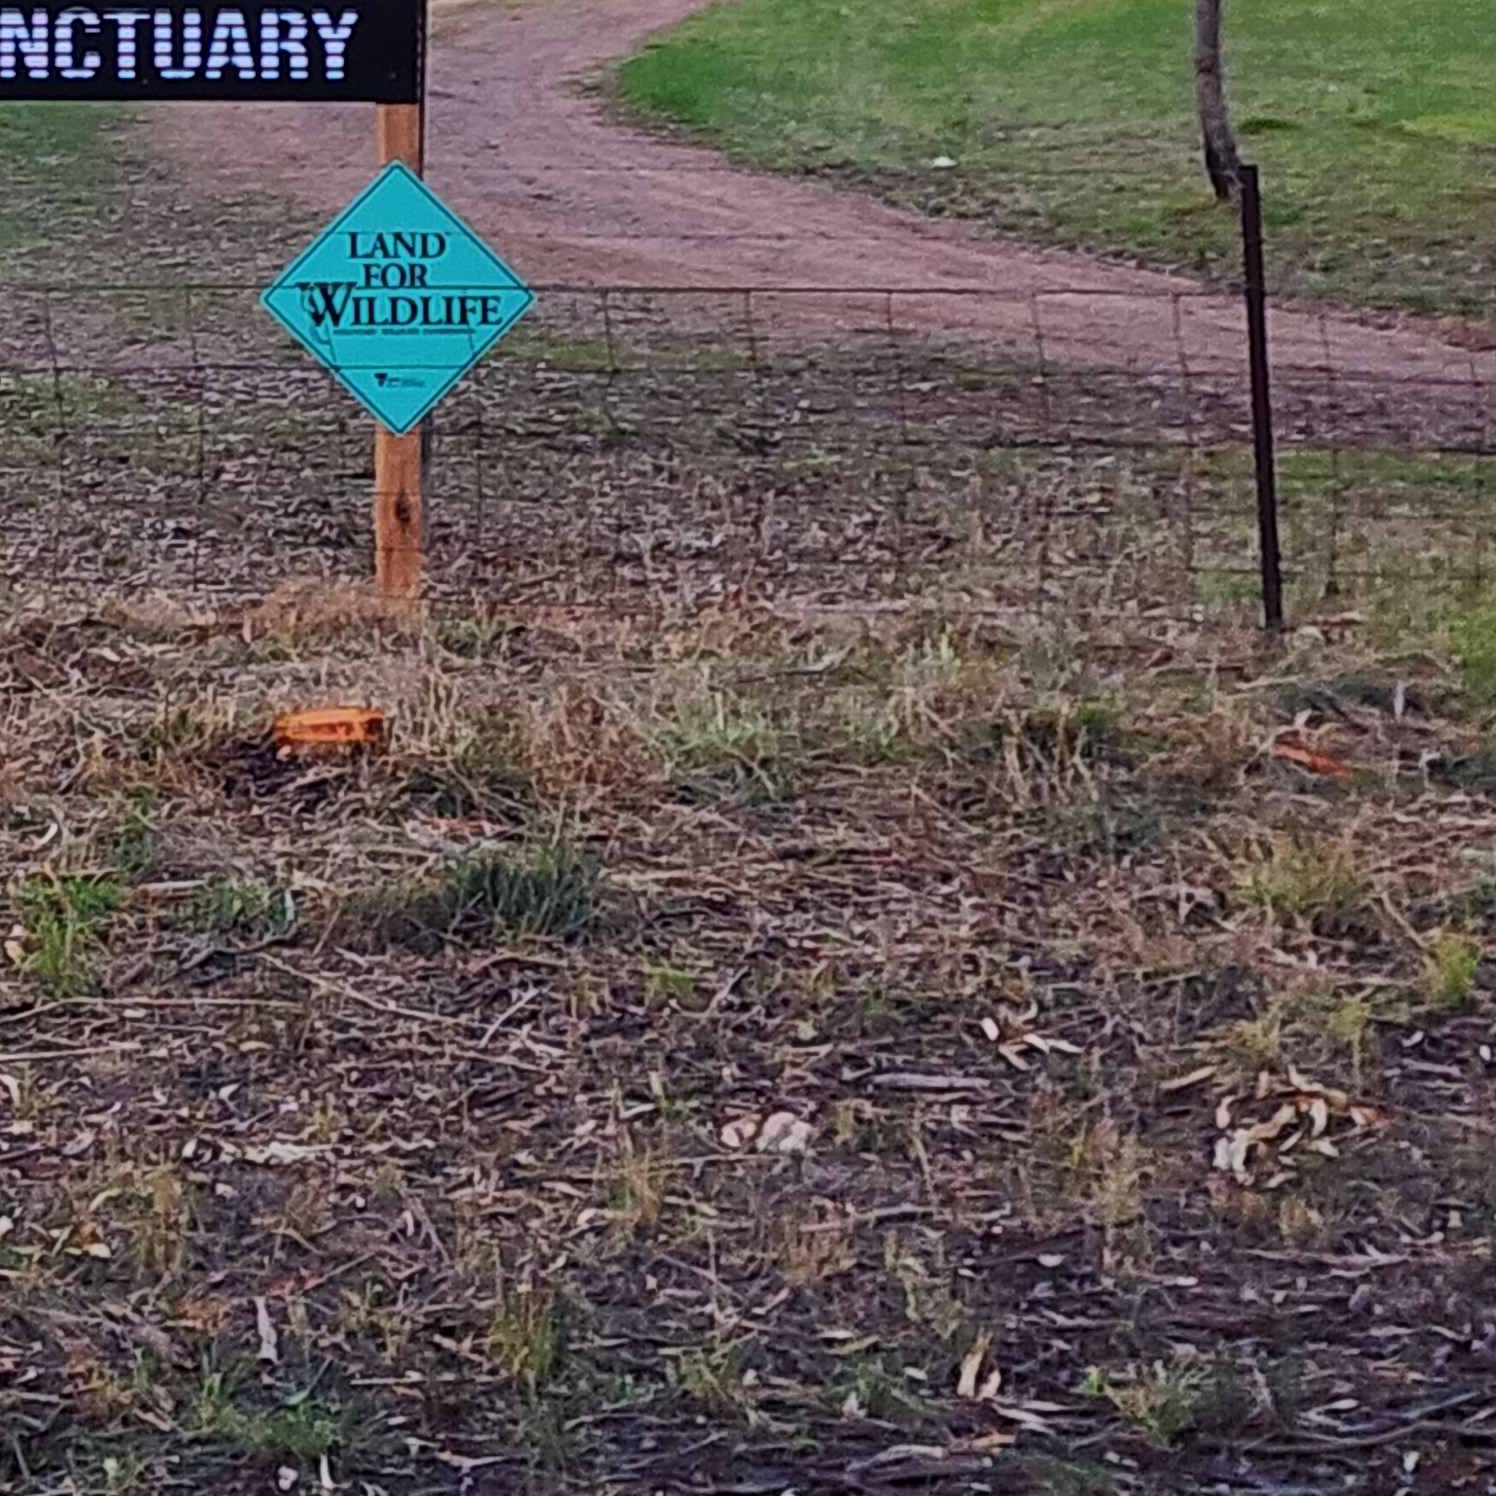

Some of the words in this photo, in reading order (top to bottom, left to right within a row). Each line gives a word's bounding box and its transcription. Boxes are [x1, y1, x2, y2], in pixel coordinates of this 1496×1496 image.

[347, 231, 446, 259] LAND
[362, 263, 430, 289] FOR
[296, 281, 502, 327] WILDLIFE
